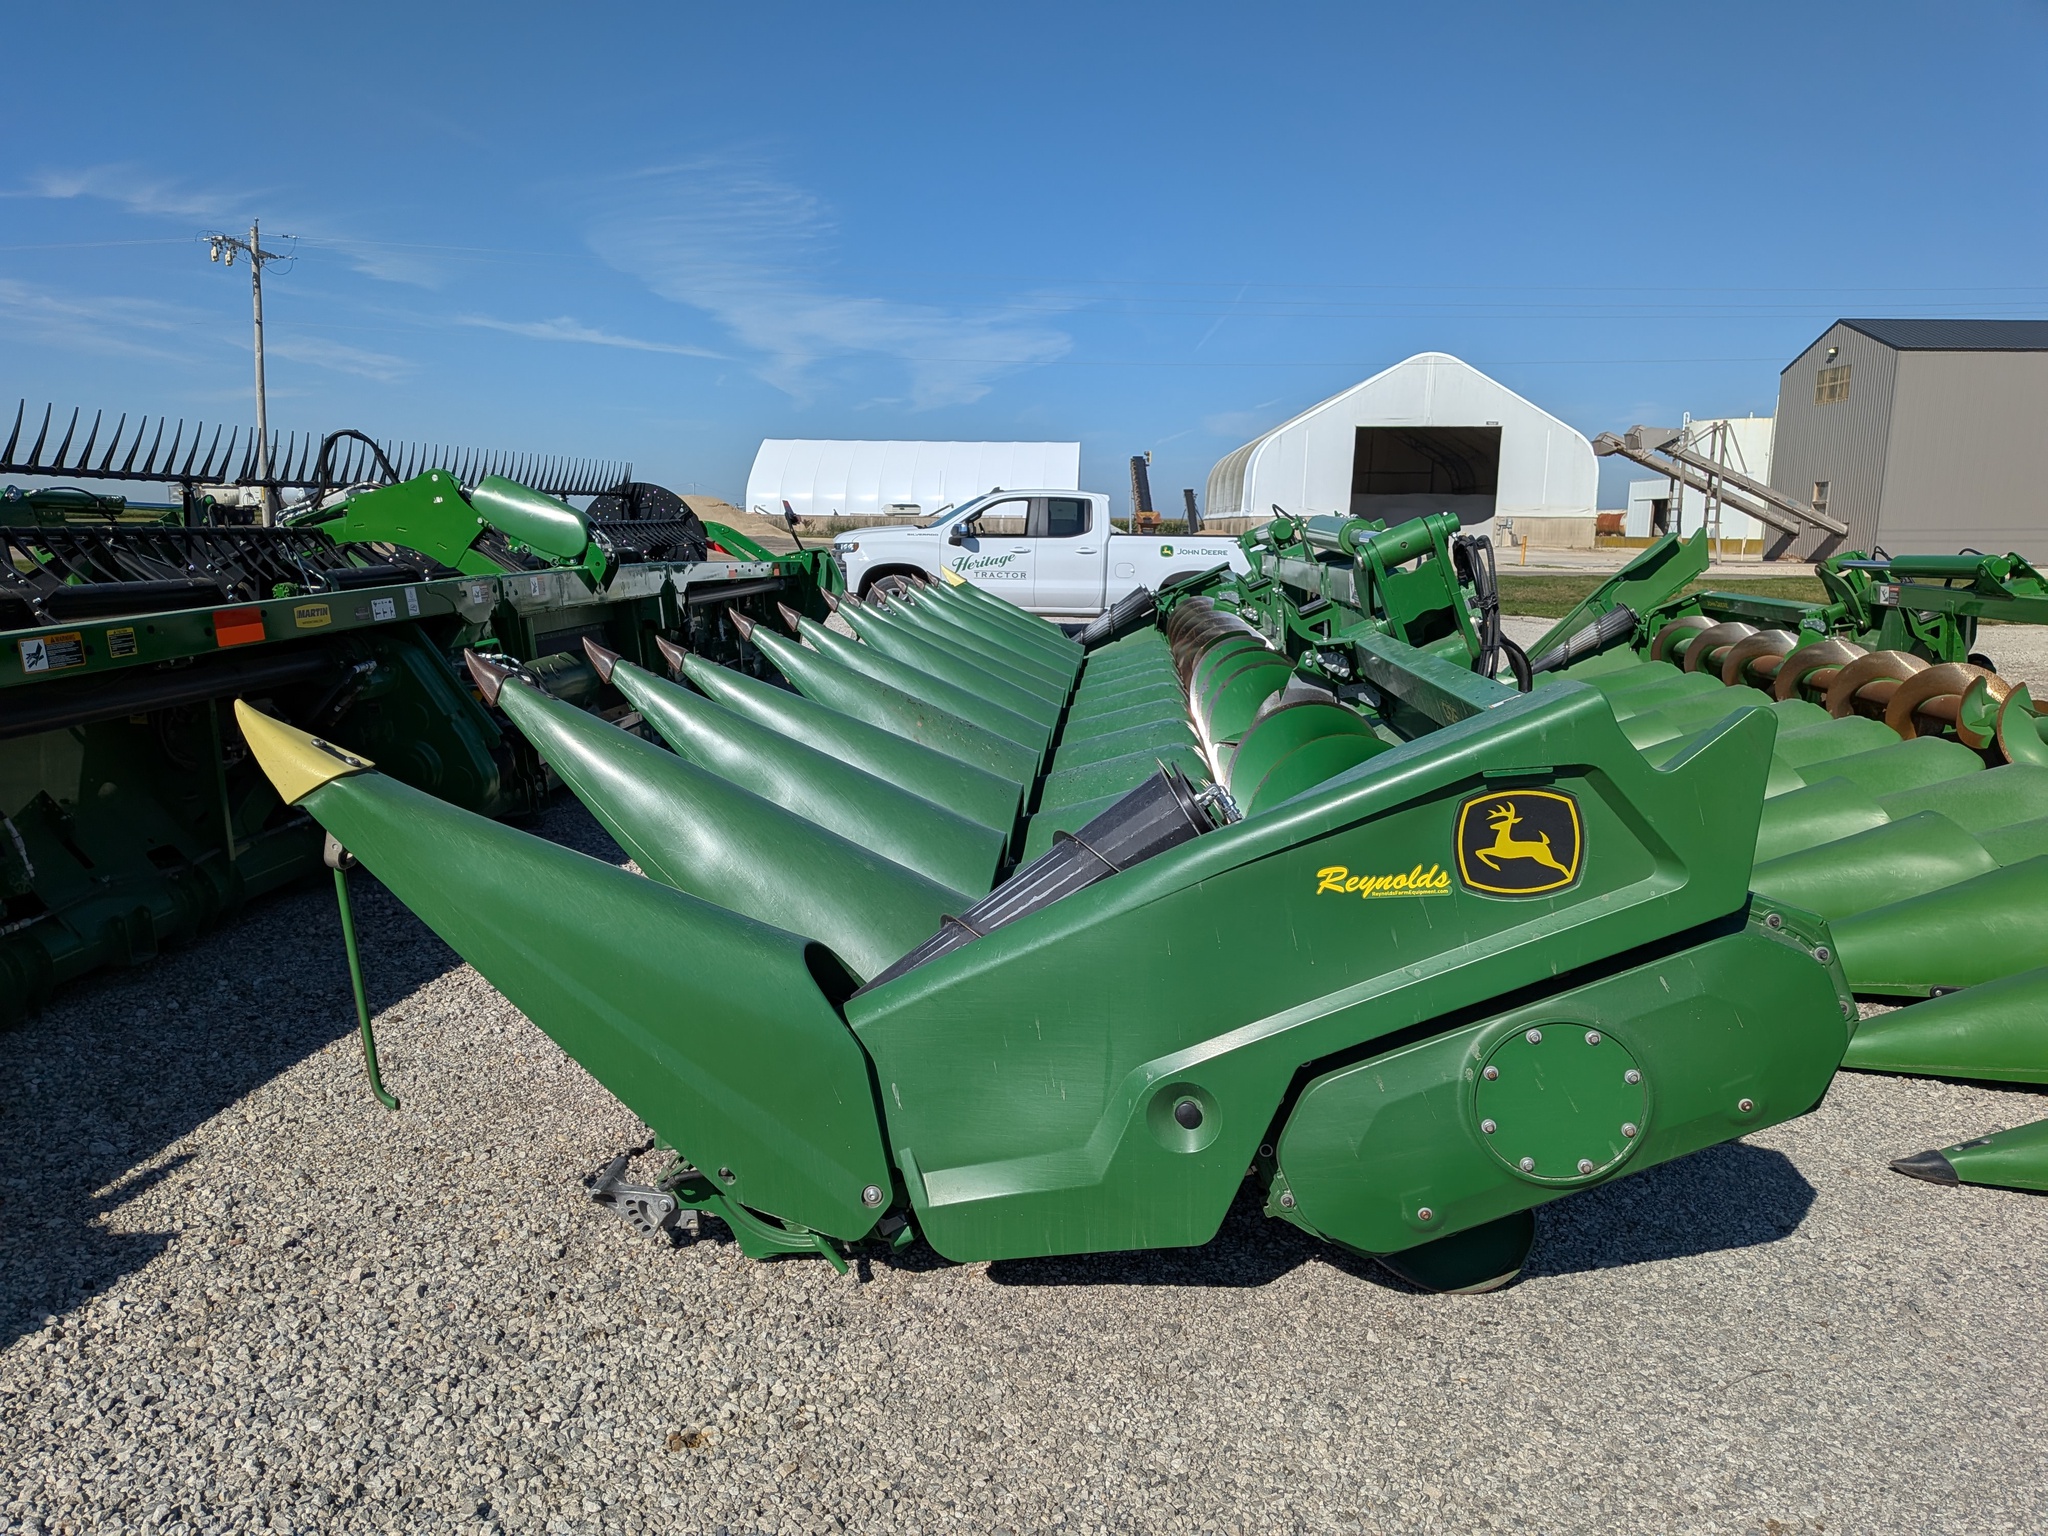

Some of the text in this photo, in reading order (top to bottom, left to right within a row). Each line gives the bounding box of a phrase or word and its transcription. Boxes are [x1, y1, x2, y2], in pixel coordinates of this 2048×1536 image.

[1201, 548, 1228, 556] DEERE
[952, 554, 1016, 574] Heritage
[974, 571, 1027, 579] TRACTOR
[296, 607, 328, 619] MARTIN
[1316, 863, 1451, 899] Reynolds
[1371, 889, 1449, 897] ReynoldsFarmEquipment.com
